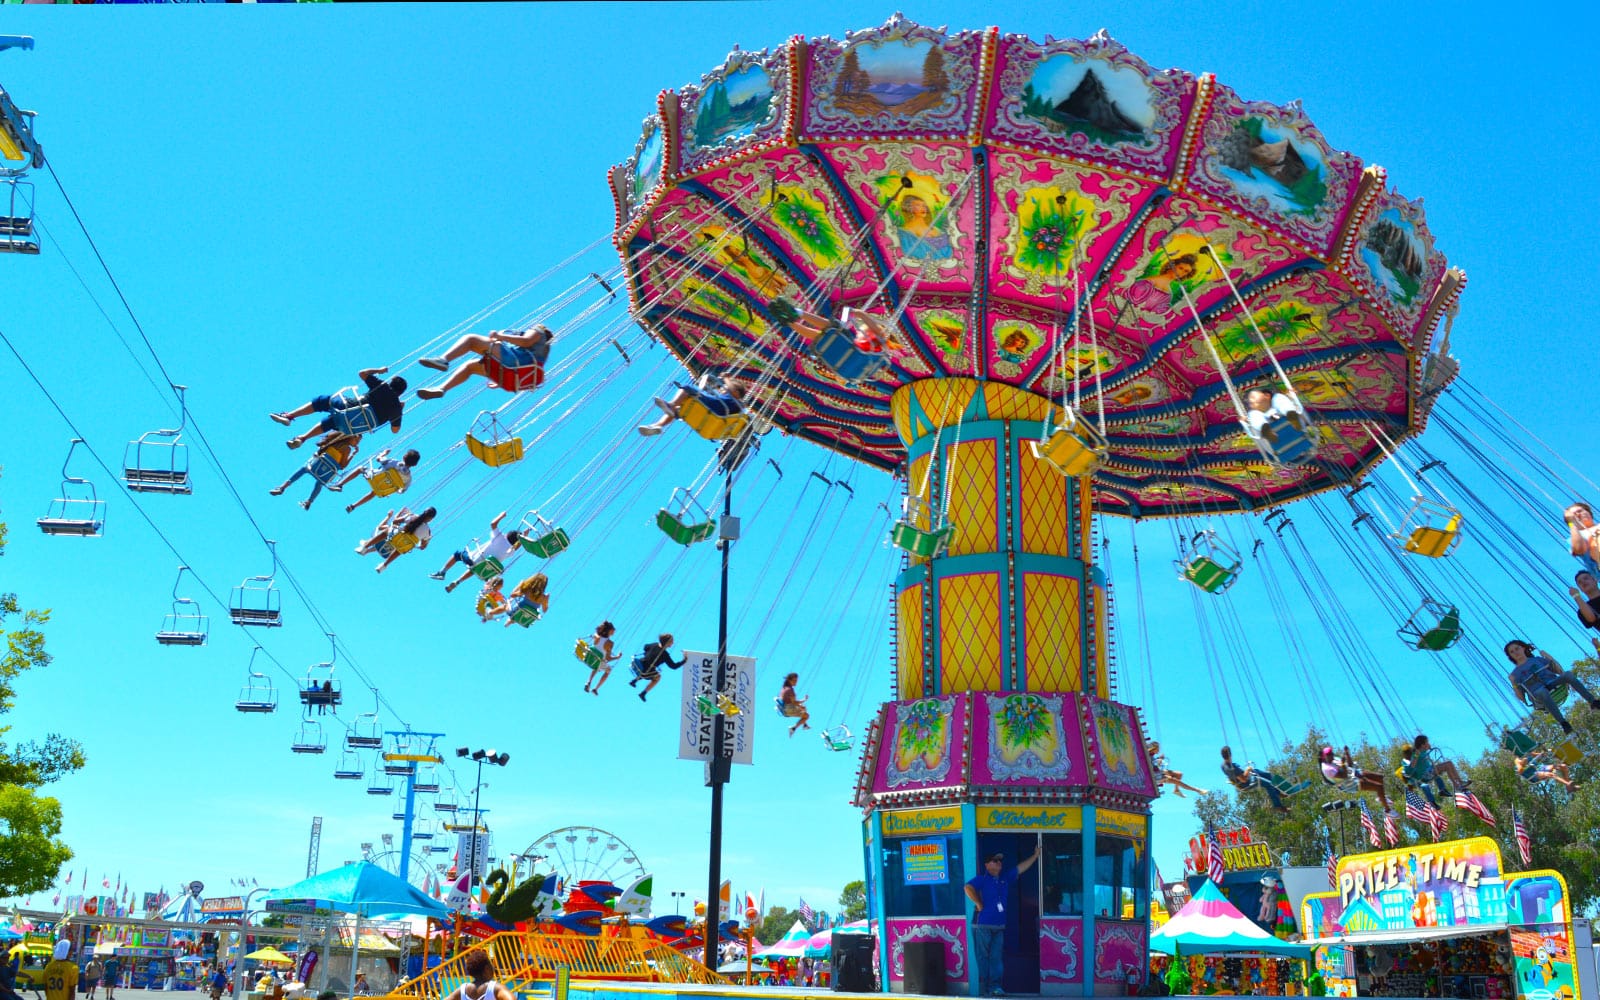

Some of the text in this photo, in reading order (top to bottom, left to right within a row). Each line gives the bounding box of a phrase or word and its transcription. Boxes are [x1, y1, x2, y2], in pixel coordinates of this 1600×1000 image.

[686, 663, 699, 747] California
[699, 658, 712, 755] STAT FAIR
[724, 721, 735, 759] FAIR
[1223, 843, 1271, 871] PRIZES
[1340, 853, 1483, 909] PRIZE TIME
[49, 977, 64, 991] 30
